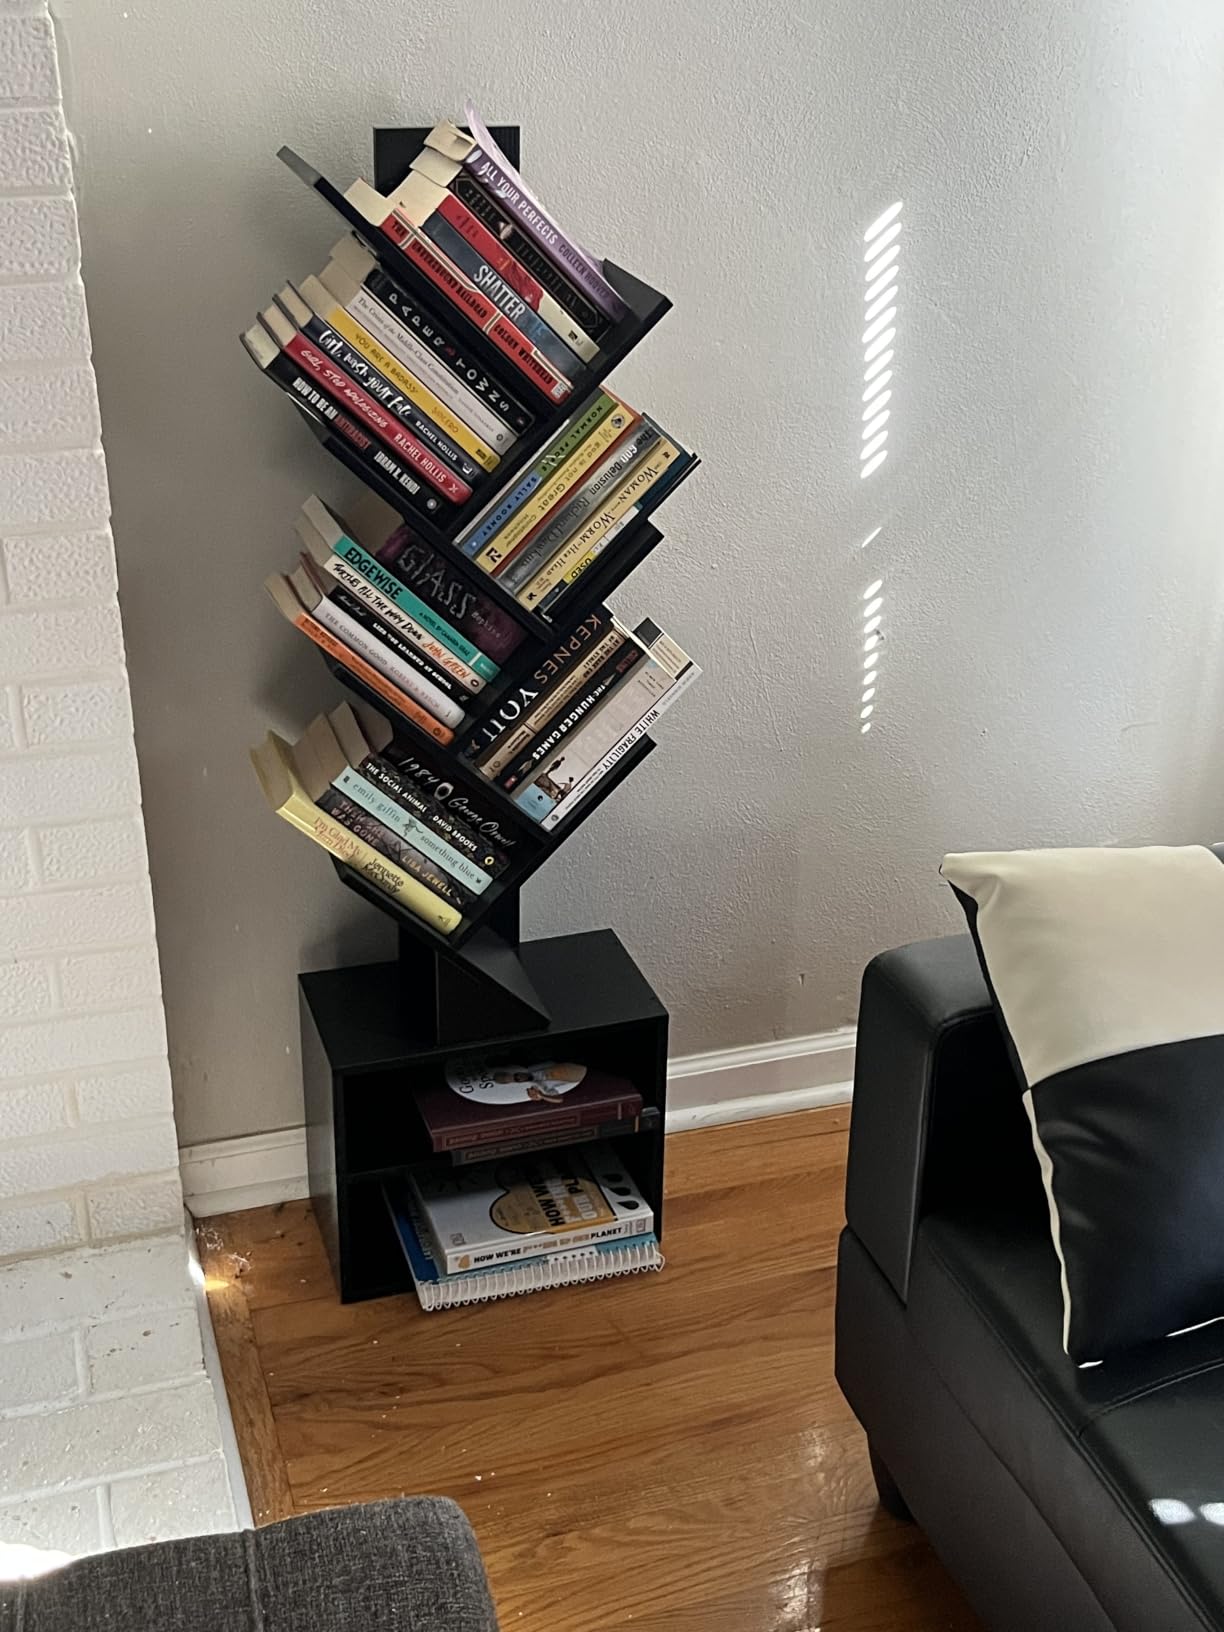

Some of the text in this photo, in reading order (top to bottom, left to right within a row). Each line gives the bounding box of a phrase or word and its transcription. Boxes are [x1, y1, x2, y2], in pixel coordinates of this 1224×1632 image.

[480, 160, 500, 179] ALL
[495, 176, 522, 202] YOUR
[516, 199, 561, 244] PERFECTS
[390, 220, 407, 237] THE
[454, 285, 489, 318] RAILROAD
[558, 242, 612, 299] COLLEEN HOOVER
[357, 296, 370, 308] The
[469, 263, 529, 321] SHATTER
[317, 327, 349, 358] Girl,
[353, 330, 373, 349] YOU
[369, 345, 386, 362] ARE
[383, 359, 392, 368] A
[387, 290, 514, 412] PAPER TOWNS
[492, 323, 520, 349] COLSON
[516, 347, 554, 384] WHITEHEAD
[291, 376, 312, 397] HOW
[306, 389, 321, 404] TO
[314, 397, 329, 412] BE
[322, 404, 338, 420] AN
[299, 346, 390, 428] GIRL, STOP APOLOGIZING
[431, 404, 462, 433] SINCERO
[570, 406, 605, 441] NORMAL
[634, 429, 653, 448] The
[392, 431, 449, 482] RACHEL HOLLIS
[414, 419, 459, 460] RACHEL HOLLIS
[540, 441, 572, 473] PEOPLE
[619, 443, 640, 465] GOD
[372, 449, 397, 473] IBRAM
[397, 472, 421, 495] KENDI
[536, 440, 602, 512] god is not Great
[588, 461, 624, 497] Delusion
[480, 477, 539, 538] SALLY ROONEY
[552, 496, 592, 535] Richard
[518, 530, 560, 571] Dawkins
[569, 556, 592, 579] USED
[331, 559, 363, 587] TURTLES
[358, 582, 376, 599] ALL
[371, 593, 389, 609] THE
[384, 605, 406, 625] WAY
[343, 545, 405, 599] EDGEWISE
[324, 612, 339, 626] THE
[337, 624, 369, 650] COMMON
[367, 647, 389, 666] GOOD
[371, 621, 388, 636] LIES
[423, 664, 433, 673] AT
[422, 636, 446, 658] JOHN
[442, 652, 472, 679] GREEN
[532, 612, 604, 688] KEPNES
[593, 683, 607, 697] THE
[556, 695, 598, 735] HUNGER
[632, 708, 660, 735] WHITE
[530, 730, 563, 762] GAMES
[599, 732, 637, 770] FRAGILITY
[366, 760, 429, 812] THE SOCIAL ANIMAL
[398, 751, 442, 790] 1984
[350, 780, 404, 823] emily giffin
[447, 789, 520, 850] George Orwell
[326, 826, 350, 846] Glad
[345, 840, 363, 857] My
[351, 822, 380, 847] GONE
[432, 812, 479, 851] DAVID BROOKS
[367, 856, 407, 887] Jennette
[400, 854, 454, 897] LISA JEWELL
[417, 832, 477, 878] something blue
[539, 1199, 566, 1226] HOW
[472, 1253, 494, 1263] HOW
[495, 1247, 522, 1259] WE'RE
[589, 1226, 622, 1239] PLANET
